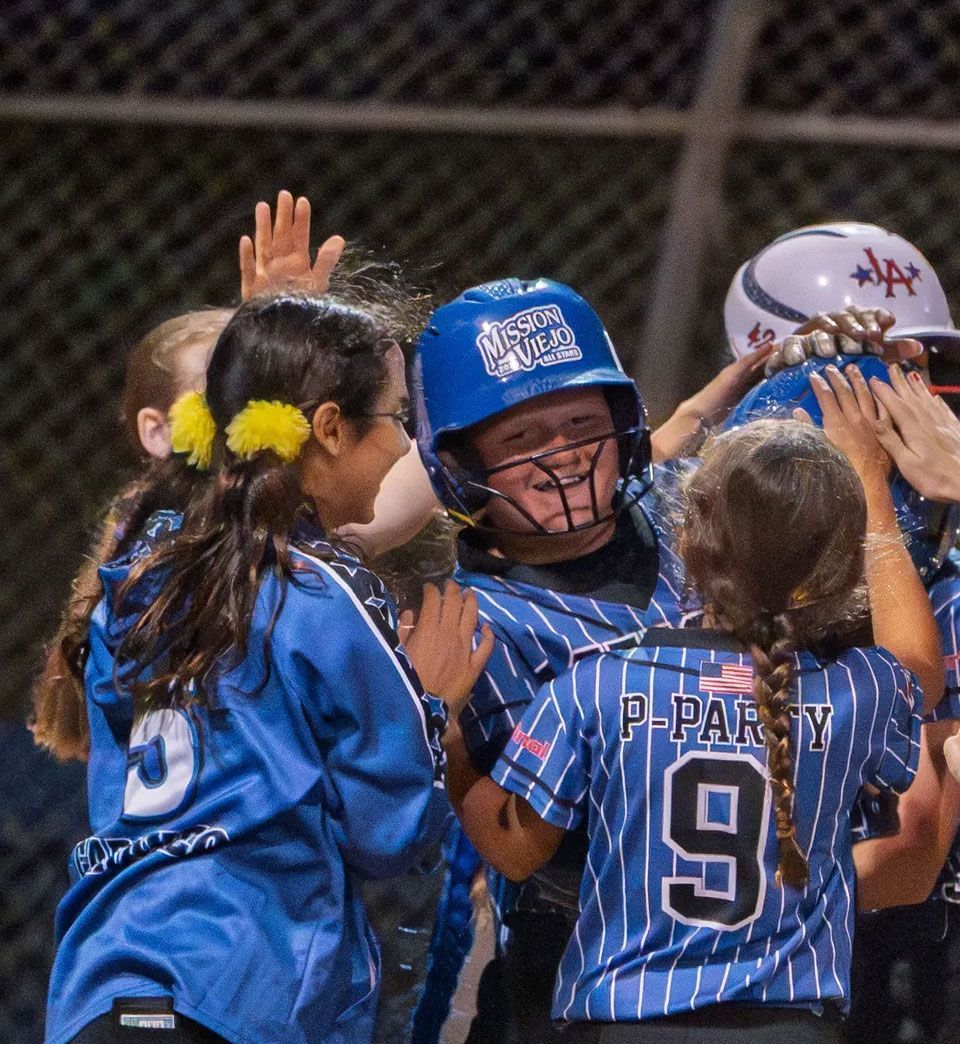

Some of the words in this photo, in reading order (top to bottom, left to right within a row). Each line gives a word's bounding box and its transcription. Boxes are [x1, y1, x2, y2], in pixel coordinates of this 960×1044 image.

[481, 308, 561, 371] MISSION
[512, 327, 572, 367] VIEJO
[620, 692, 833, 752] P-PARY
[661, 750, 771, 931] 9
